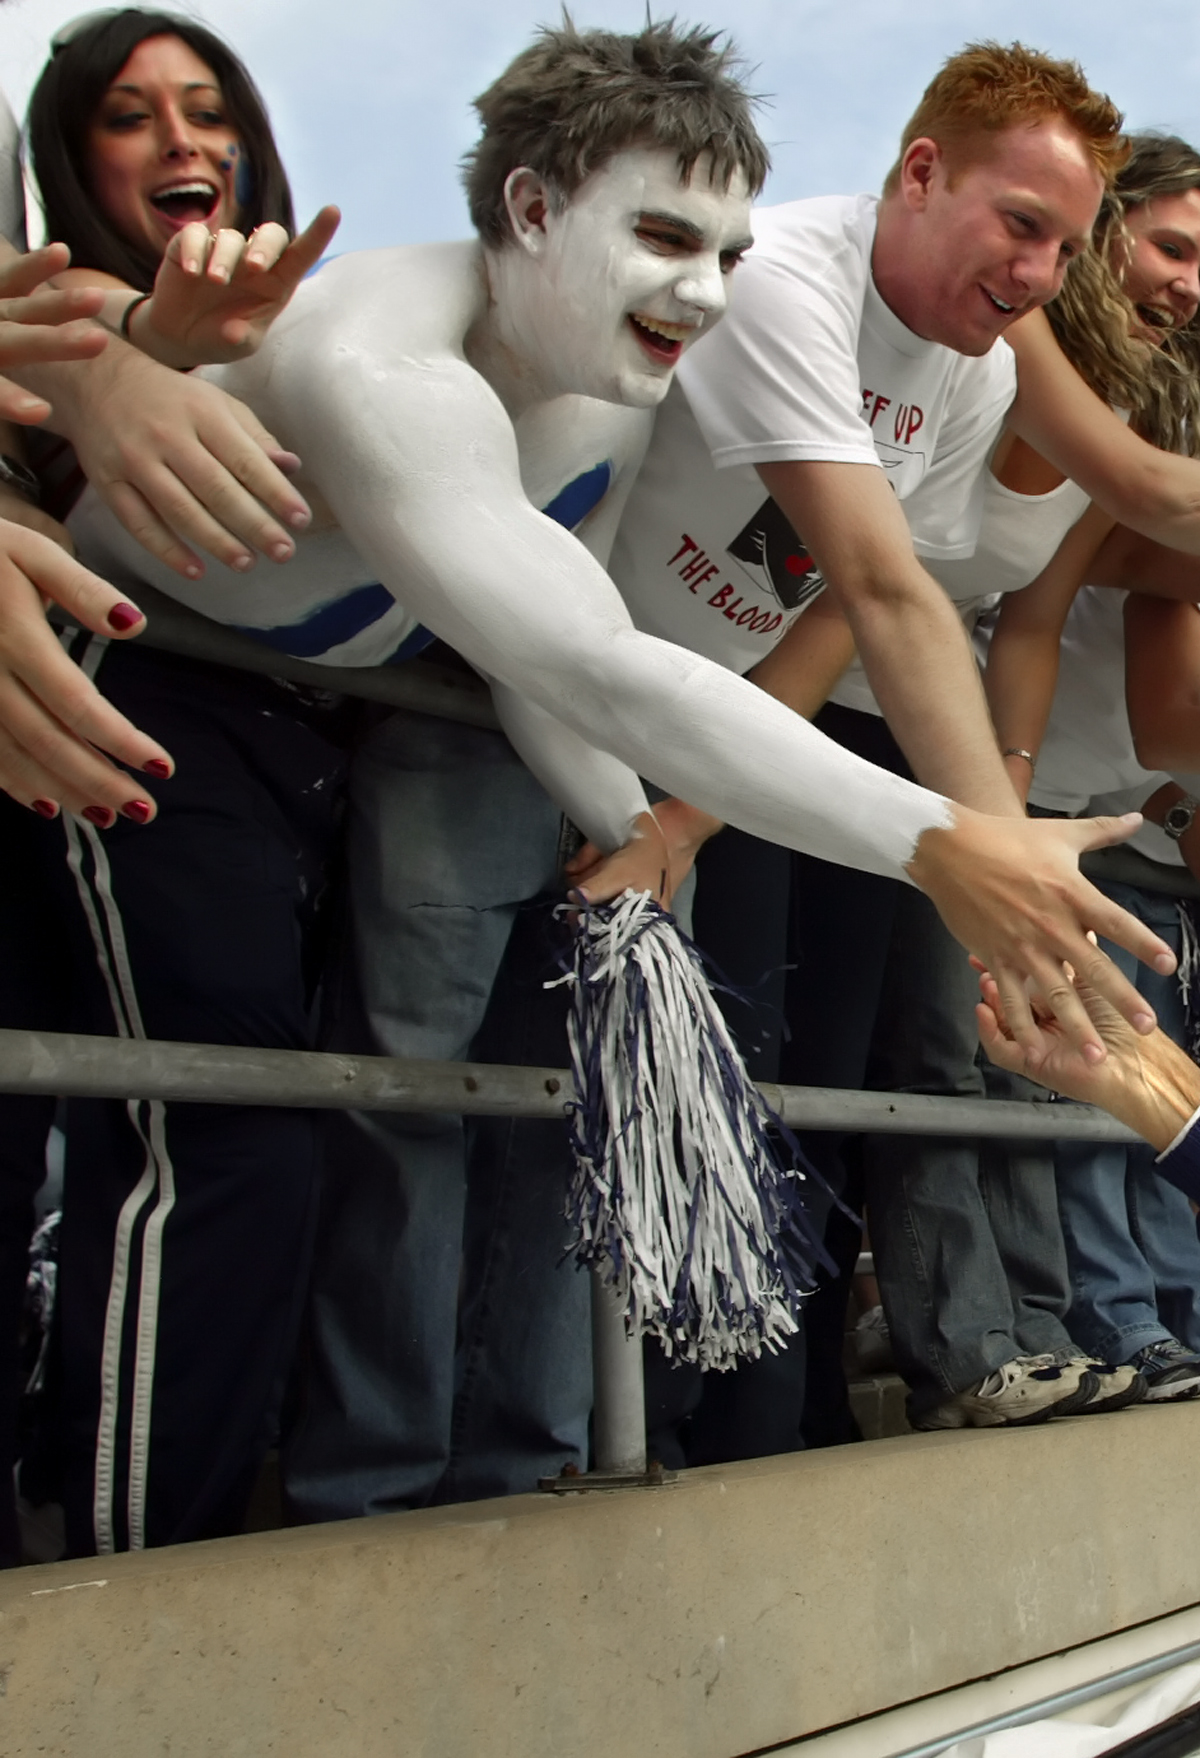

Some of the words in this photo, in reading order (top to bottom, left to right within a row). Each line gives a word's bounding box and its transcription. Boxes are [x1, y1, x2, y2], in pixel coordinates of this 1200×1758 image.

[894, 403, 924, 445] UP
[666, 533, 720, 595] THE
[707, 582, 783, 634] BLOOD
